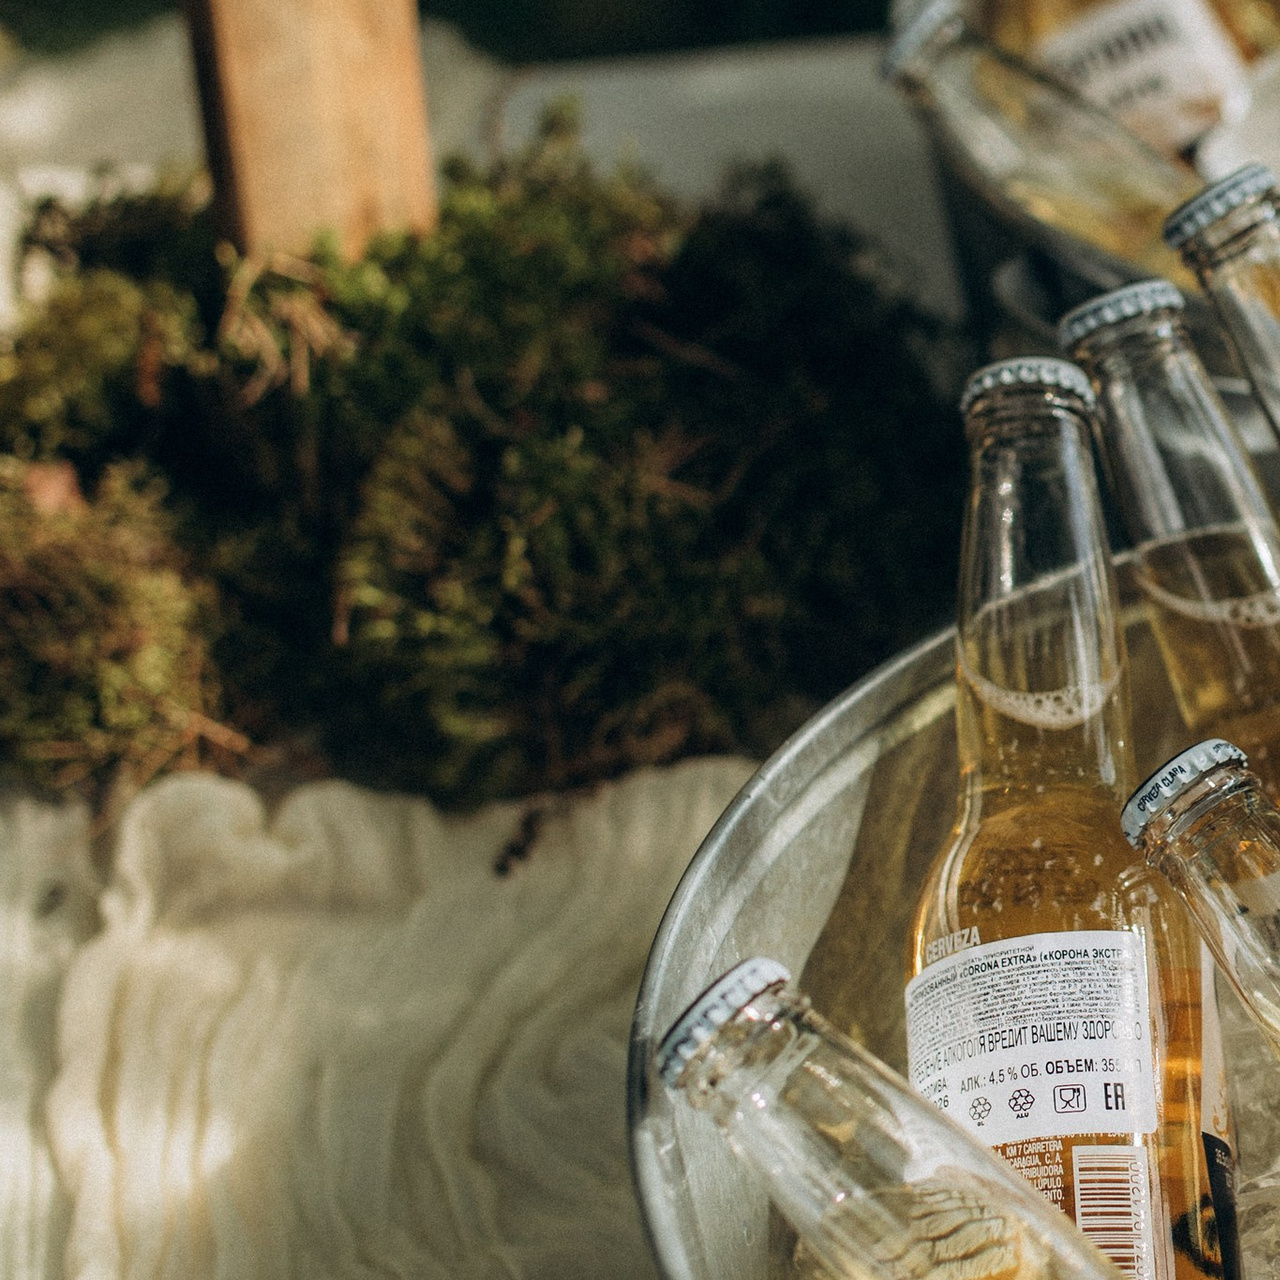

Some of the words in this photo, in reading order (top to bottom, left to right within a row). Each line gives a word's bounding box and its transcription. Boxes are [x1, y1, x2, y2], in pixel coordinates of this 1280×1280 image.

[1137, 783, 1163, 812] CERVEZA
[1161, 765, 1186, 788] CLARA
[925, 925, 982, 964] CERVEZA
[988, 1026, 1029, 1053] ВРЕДИТ
[1031, 1020, 1079, 1044] ВАШЕМУ
[988, 1069, 1005, 1085] 4.5
[1045, 1058, 1099, 1075] ОБЪЕМ:
[1023, 1140, 1064, 1155] CARRETERA
[1005, 1156, 1042, 1171] CARAGUA,
[1019, 1165, 1064, 1180] TRIBUIDORA
